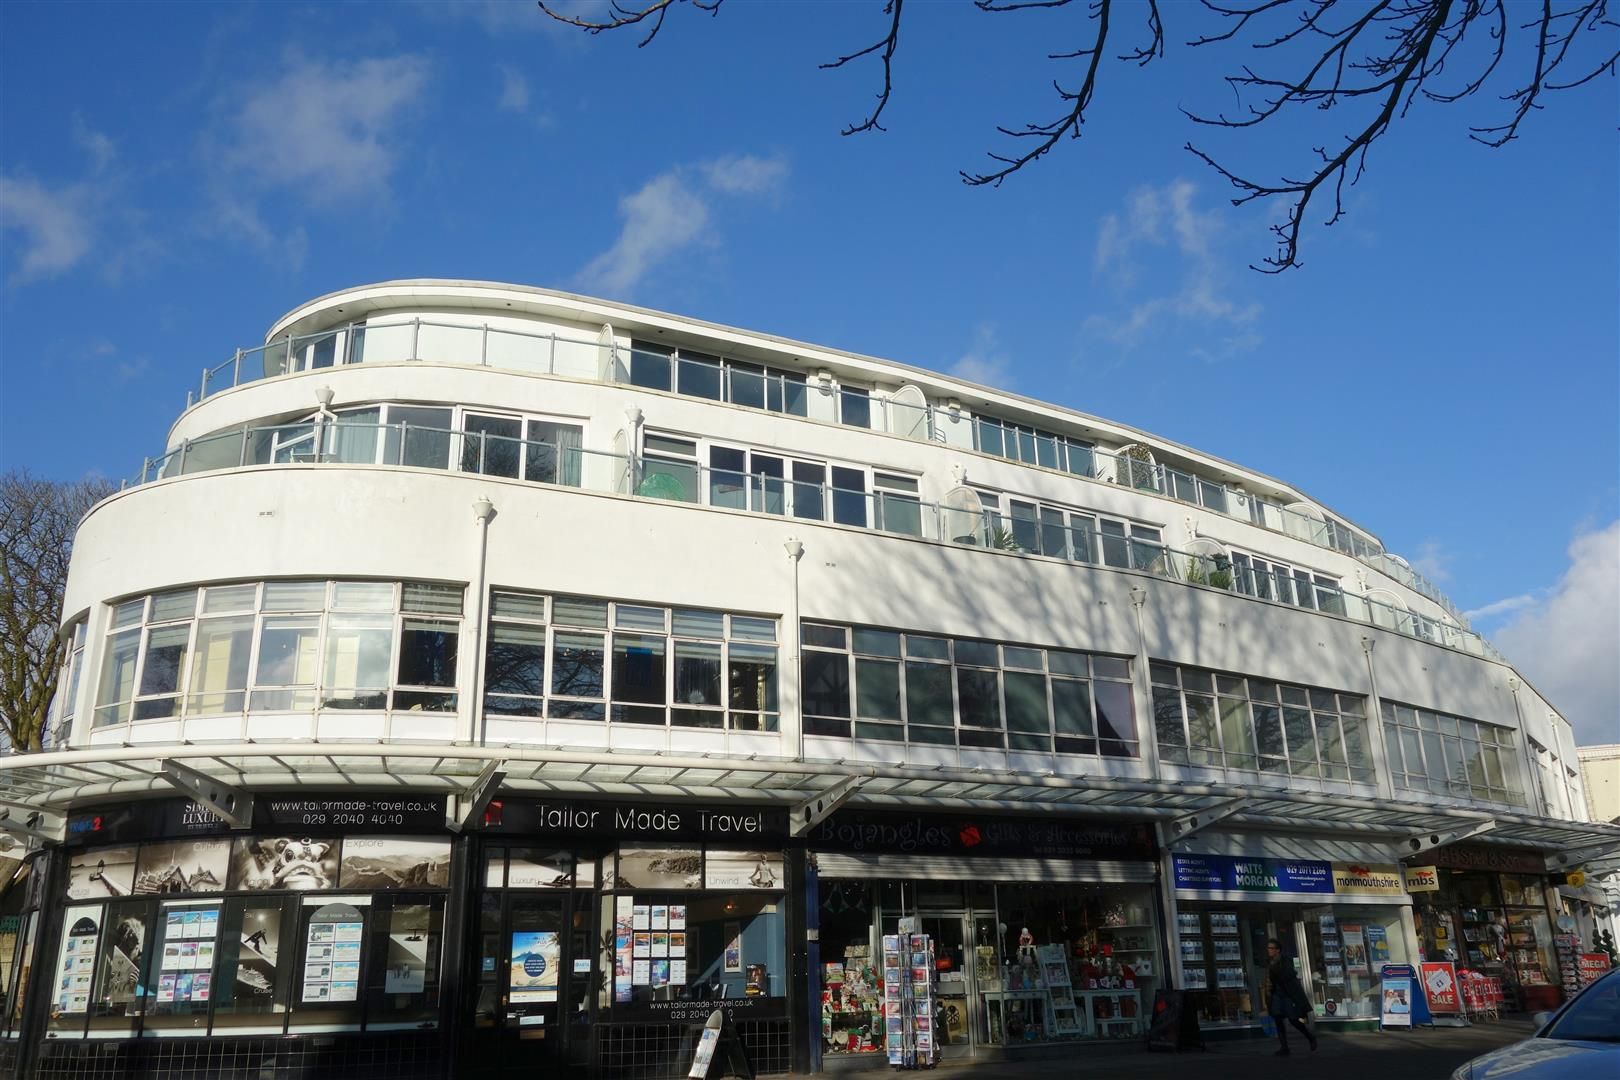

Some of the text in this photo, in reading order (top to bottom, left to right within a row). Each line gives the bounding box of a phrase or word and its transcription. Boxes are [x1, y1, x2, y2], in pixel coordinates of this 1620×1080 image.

[271, 800, 437, 812] www.tailormade-travel.co.uk
[302, 813, 403, 825] 029 2040 4040
[536, 804, 762, 833] Tailor Made Travel
[820, 815, 952, 851] Bojangles
[346, 839, 384, 849] Explore
[1234, 861, 1263, 875] WATTS
[1286, 864, 1298, 875] 029
[1298, 864, 1312, 875] 2071
[709, 876, 739, 885] Unwind
[1235, 875, 1278, 888] MORGAN
[1336, 876, 1400, 888] monmouthshire
[1408, 876, 1435, 887] mbs
[1581, 959, 1607, 969] MEGA
[1435, 979, 1445, 988] £1
[650, 999, 754, 1010] www.tailormade-travel.co.uk
[1431, 994, 1455, 1005] SALE
[670, 1009, 710, 1020] 029 2040
